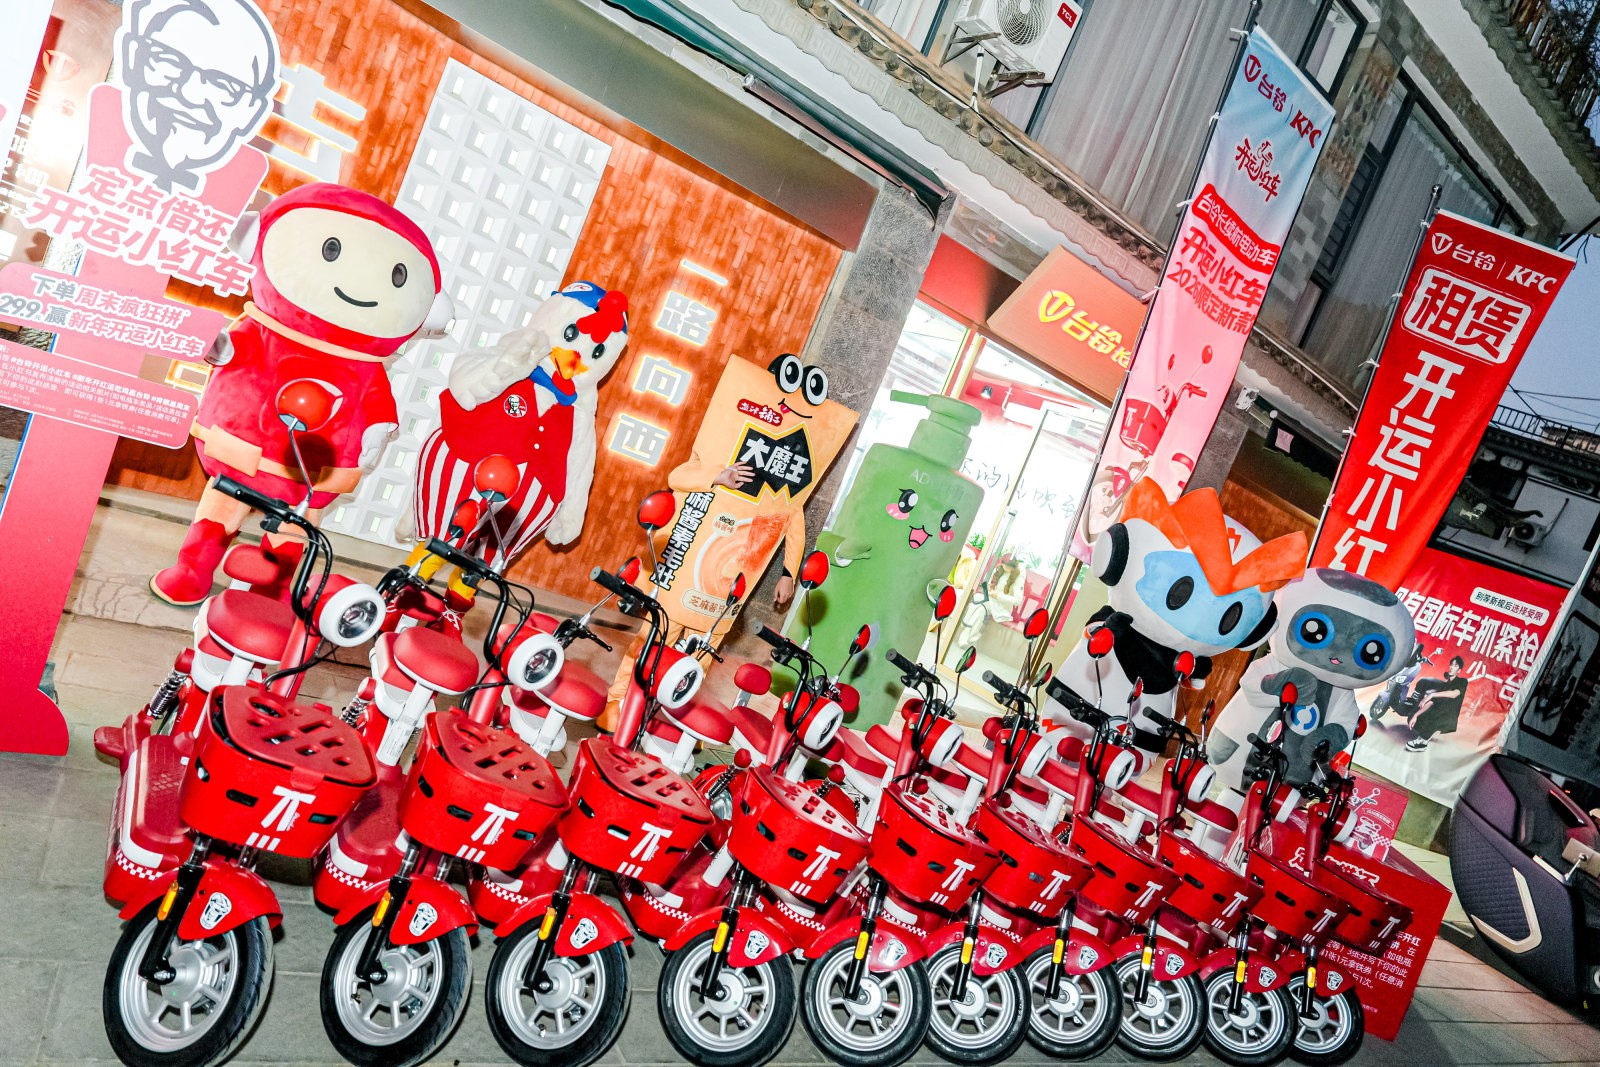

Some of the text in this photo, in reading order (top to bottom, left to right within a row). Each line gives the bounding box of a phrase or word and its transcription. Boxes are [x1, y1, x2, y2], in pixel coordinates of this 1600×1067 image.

[1062, 8, 1073, 22] TCL
[1258, 74, 1322, 148] 台铃 KFC
[26, 189, 254, 291] 开运小红车
[80, 168, 234, 246] 定点借还
[34, 276, 183, 328] 下单周末疯狂拼
[1180, 226, 1266, 308] 开运小红车
[1452, 244, 1558, 294] 台铃 KFC
[44, 306, 205, 356] 赢新年开运小红车
[1410, 274, 1525, 360] 租赁
[608, 258, 729, 466] 一路向西
[740, 437, 809, 484] 大魔王
[1328, 350, 1466, 577] 开运小红
